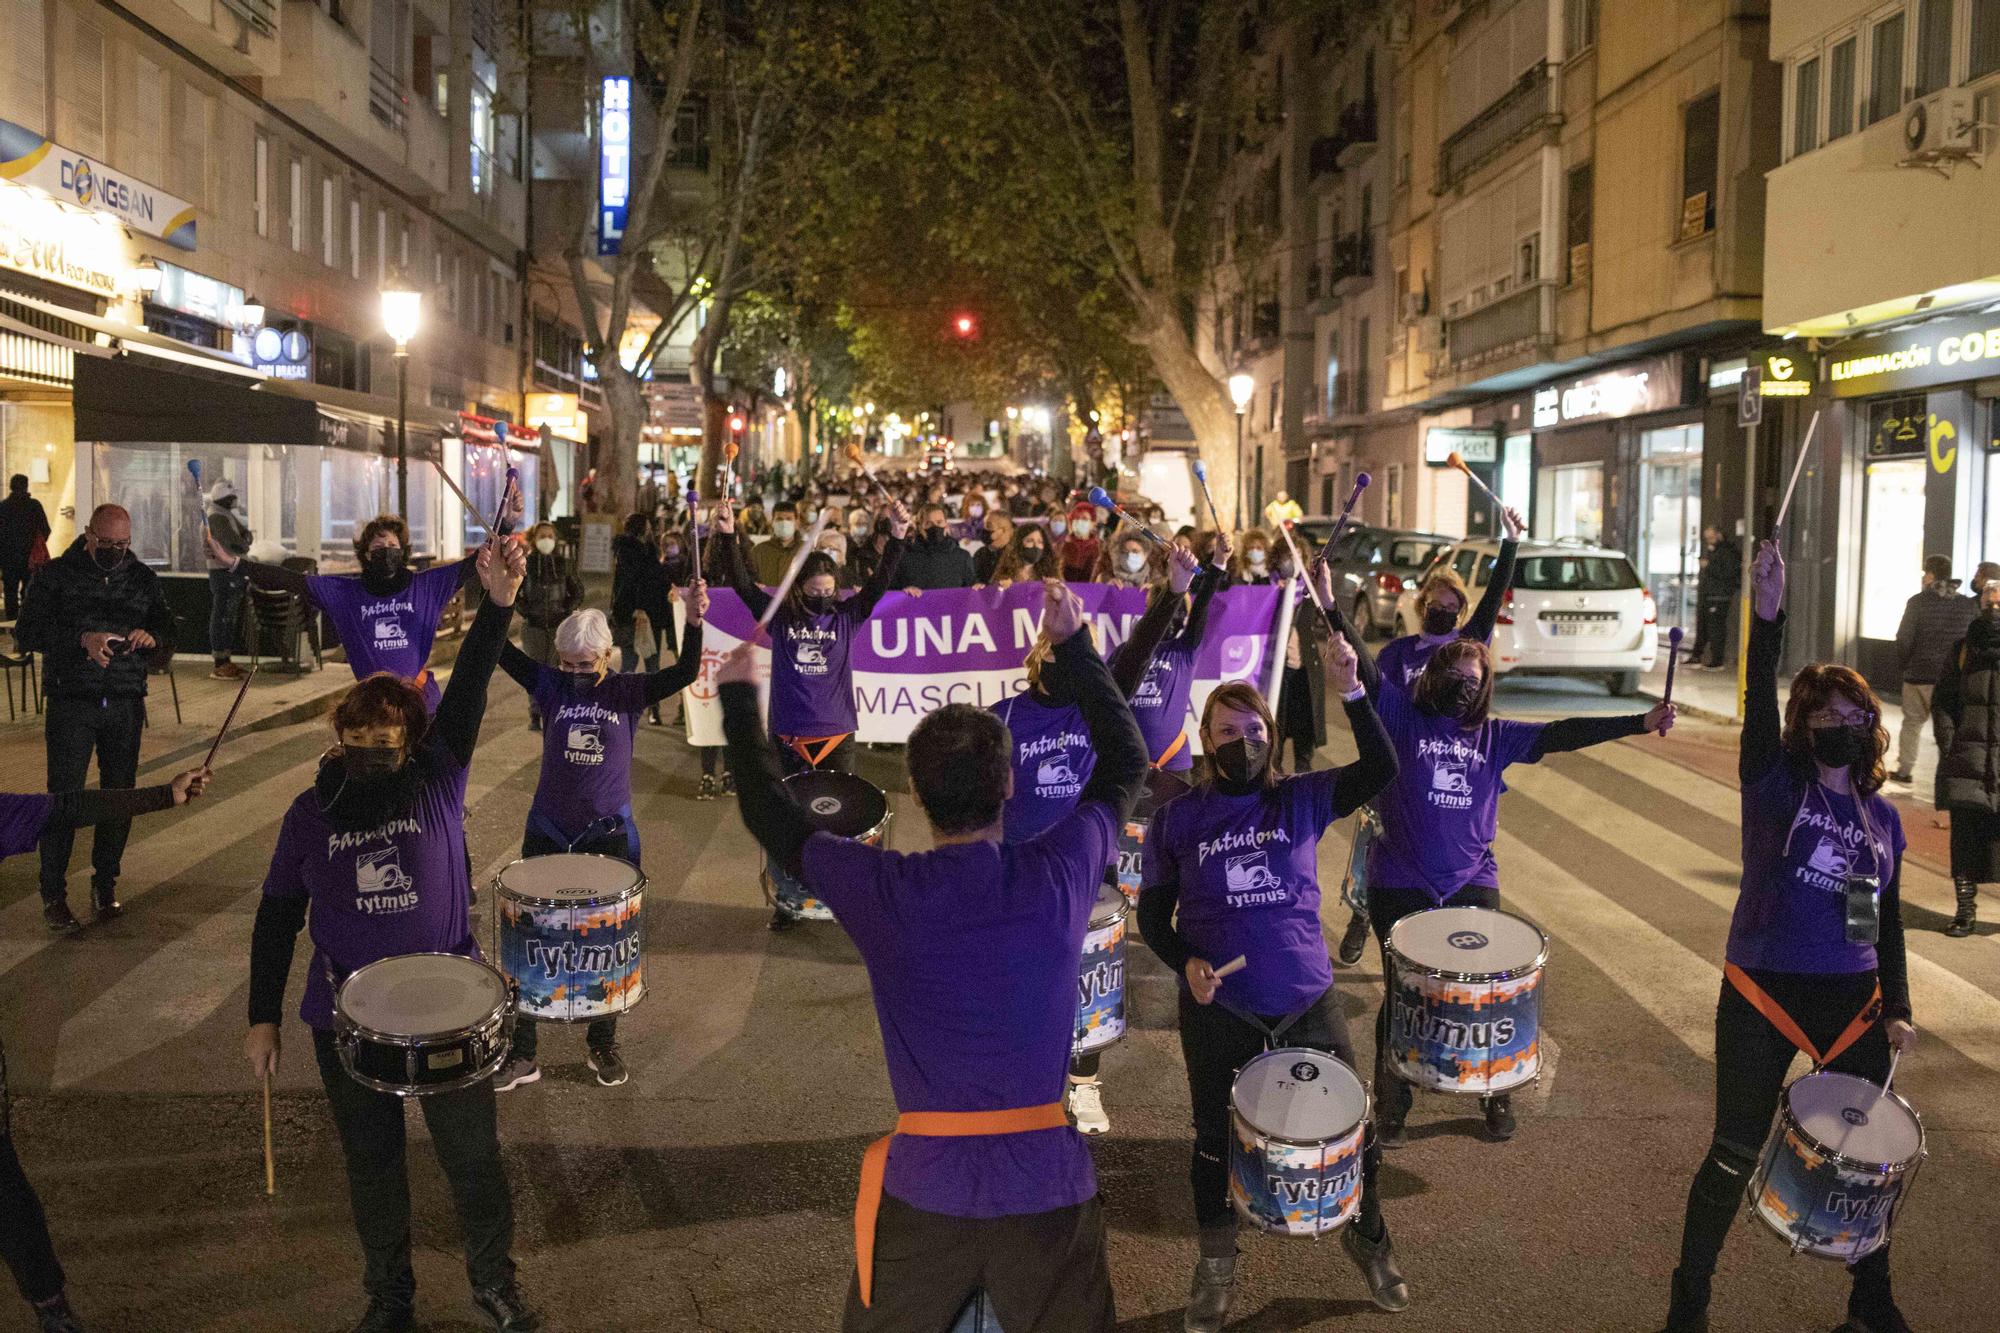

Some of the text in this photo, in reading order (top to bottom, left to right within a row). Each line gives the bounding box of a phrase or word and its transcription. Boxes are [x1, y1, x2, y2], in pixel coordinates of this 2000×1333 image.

[603, 79, 630, 239] HOTEL
[61, 158, 153, 222] DONGSAN
[1831, 343, 1931, 381] ILUMINACIÓN
[361, 598, 415, 621] Batudona
[373, 638, 409, 650] rytmus
[870, 607, 1143, 659] UNA MN
[554, 702, 620, 725] Batudona
[564, 749, 604, 764] rytmus
[1019, 730, 1089, 766] Batudona
[1417, 738, 1487, 764] Batudona
[1035, 782, 1081, 799] rytmus
[1427, 790, 1473, 807] rytmus
[1198, 826, 1291, 868] Batudona
[1795, 866, 1848, 895] rytmu
[355, 890, 419, 915] rytmus
[1226, 888, 1287, 908] rytmus
[525, 931, 641, 980] rytmus
[1393, 992, 1517, 1051] rytmus
